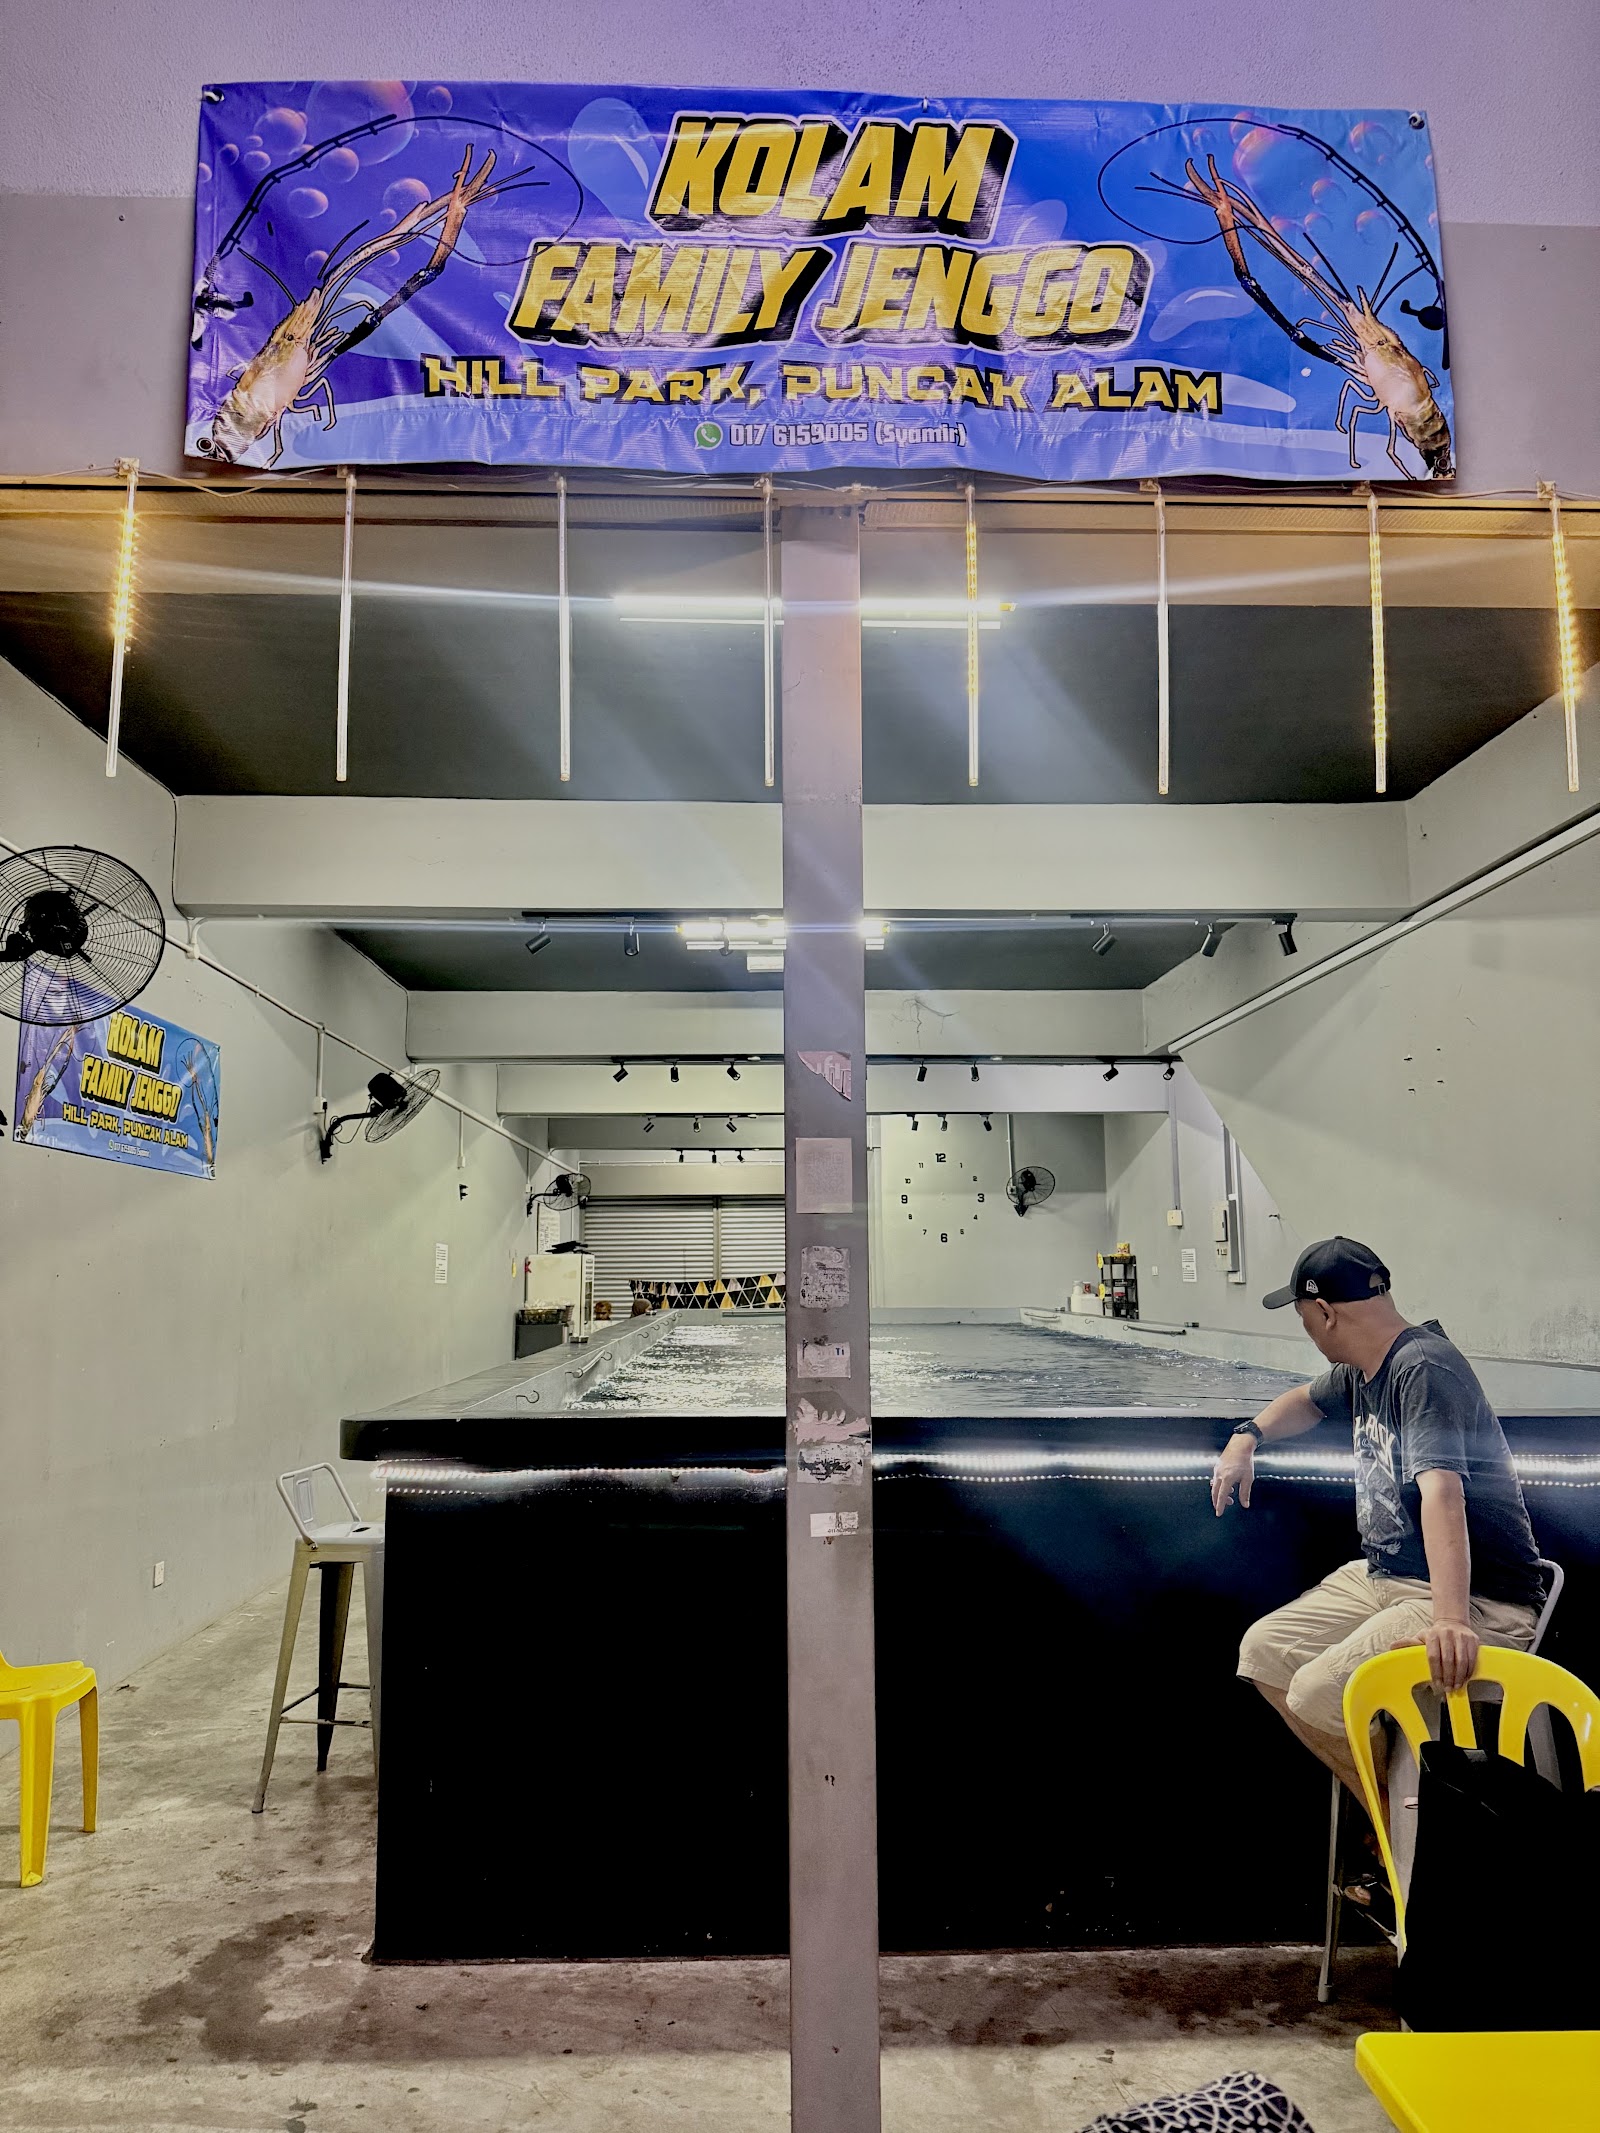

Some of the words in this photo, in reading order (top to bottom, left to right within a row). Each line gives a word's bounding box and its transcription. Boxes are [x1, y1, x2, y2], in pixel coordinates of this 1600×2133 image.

[653, 119, 1003, 226] KOLAM
[508, 241, 824, 338] FAMILY
[814, 243, 1140, 342] JENGGO
[423, 356, 562, 397] HILL
[580, 364, 762, 404] PARK,
[781, 363, 1029, 410] PUNCAK
[1052, 369, 1219, 411] ALAM
[729, 422, 768, 447] 017
[773, 421, 869, 447] 6159005
[875, 421, 968, 448] (Syamir)
[80, 1055, 133, 1106] FAMILY
[130, 1073, 182, 1120] JENGGO
[62, 1102, 88, 1124] HILL
[90, 1110, 121, 1136] PARK,
[123, 1120, 163, 1143] PUNCAK
[163, 1129, 188, 1149] ALAM
[935, 1153, 946, 1163] 12
[977, 1193, 985, 1203] 3
[940, 1233, 948, 1243] 6
